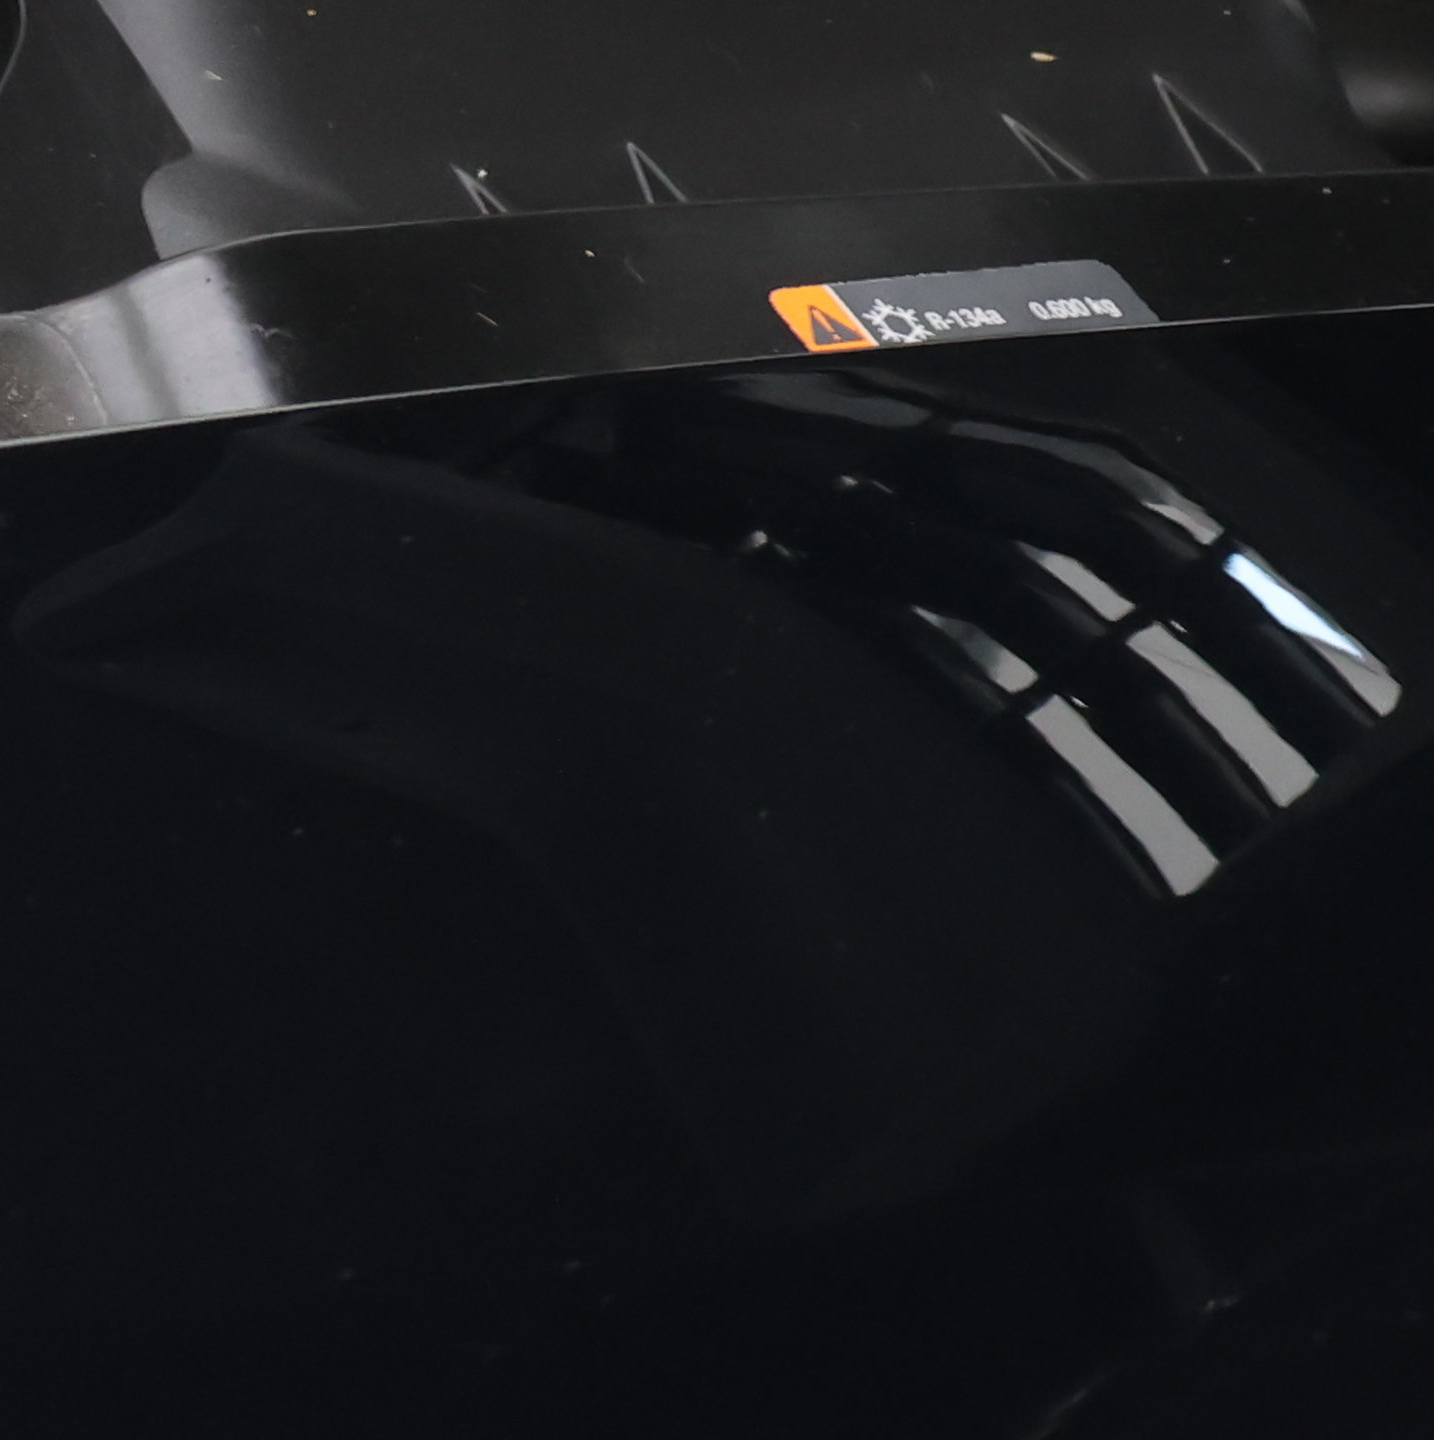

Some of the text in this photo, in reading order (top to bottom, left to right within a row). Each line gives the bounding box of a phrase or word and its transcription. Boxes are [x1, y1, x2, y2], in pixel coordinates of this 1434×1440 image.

[923, 295, 1123, 332] R-134a 0.600 kg
